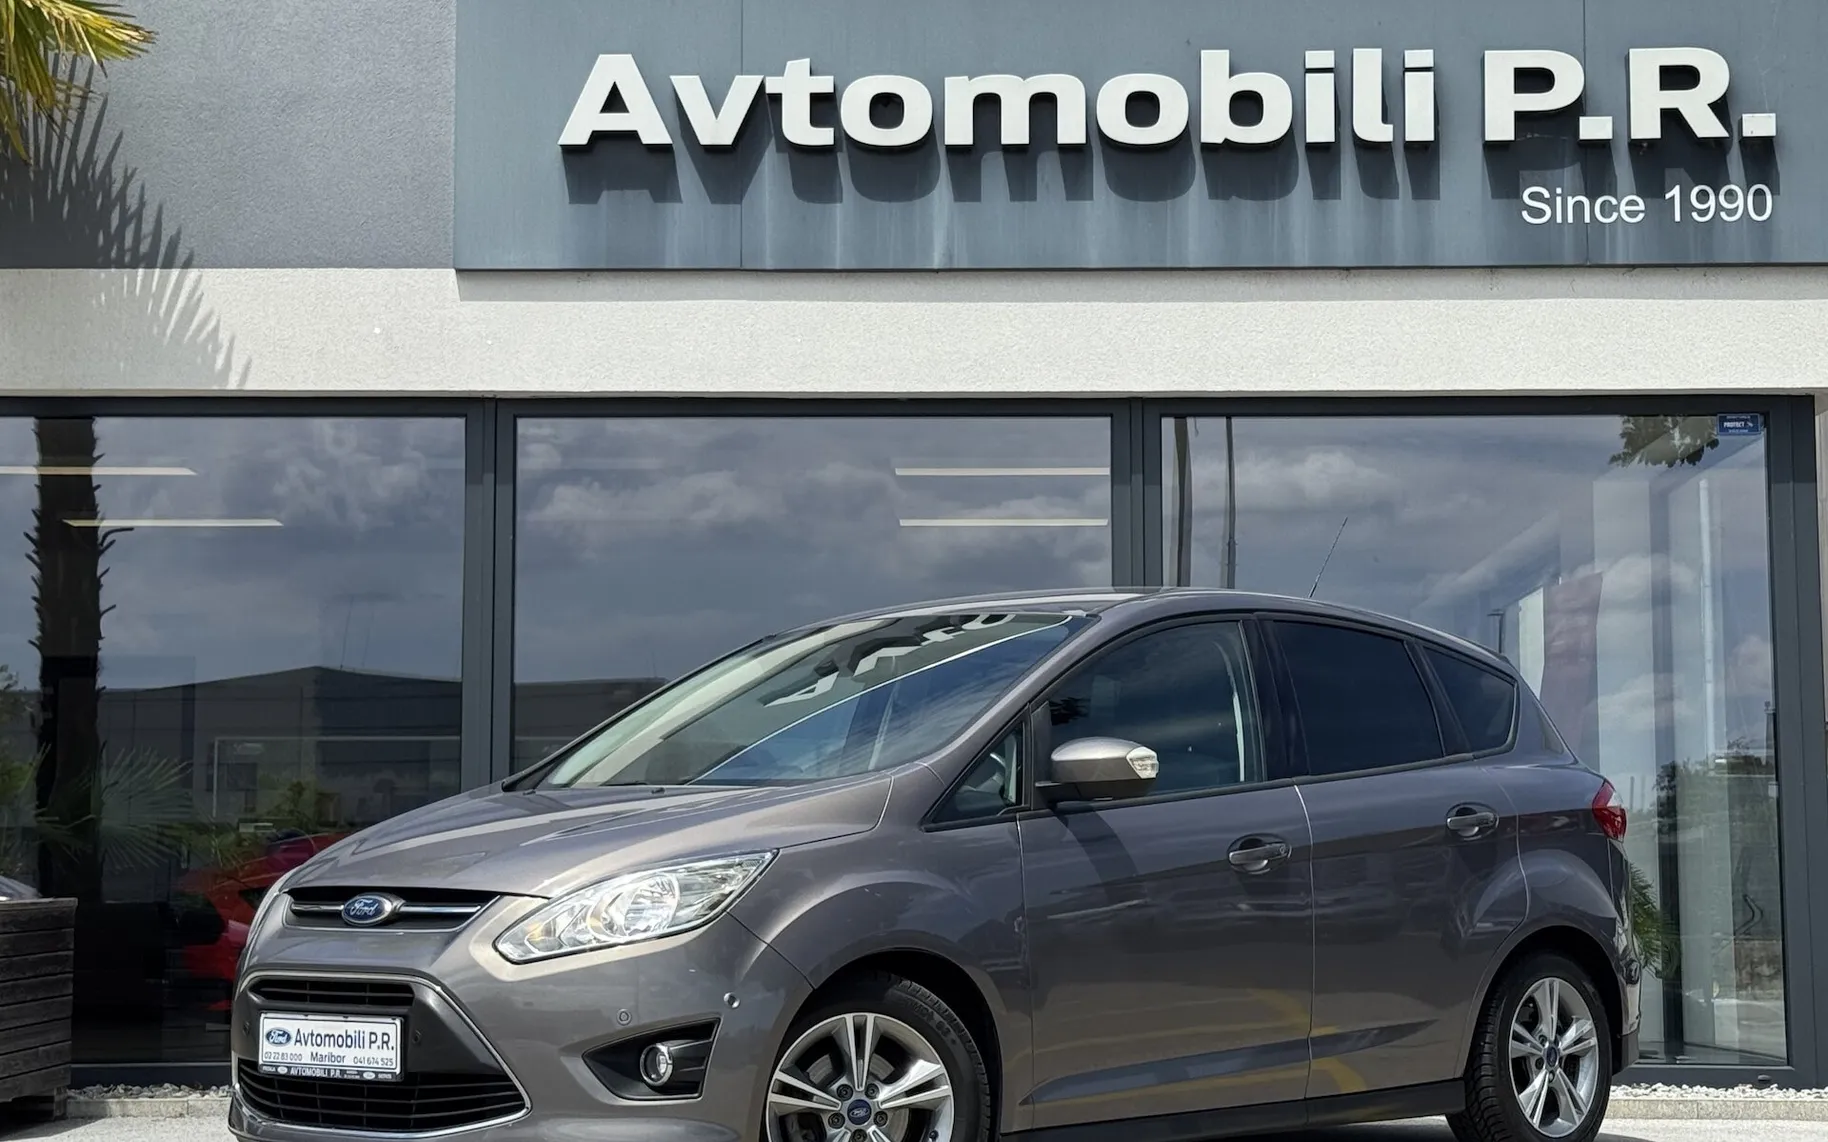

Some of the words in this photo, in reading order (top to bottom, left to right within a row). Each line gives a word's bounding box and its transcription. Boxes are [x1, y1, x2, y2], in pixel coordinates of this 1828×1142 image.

[558, 49, 1434, 147] Avtomobili
[1483, 47, 1777, 141] P.R.
[1521, 186, 1646, 224] Since
[1664, 184, 1773, 223] 1990
[350, 898, 379, 916] Ford
[294, 1028, 365, 1049] Avtomobili
[368, 1032, 394, 1050] P.R.
[310, 1052, 346, 1063] Maribor
[290, 1067, 327, 1077] AVTOMOBILI
